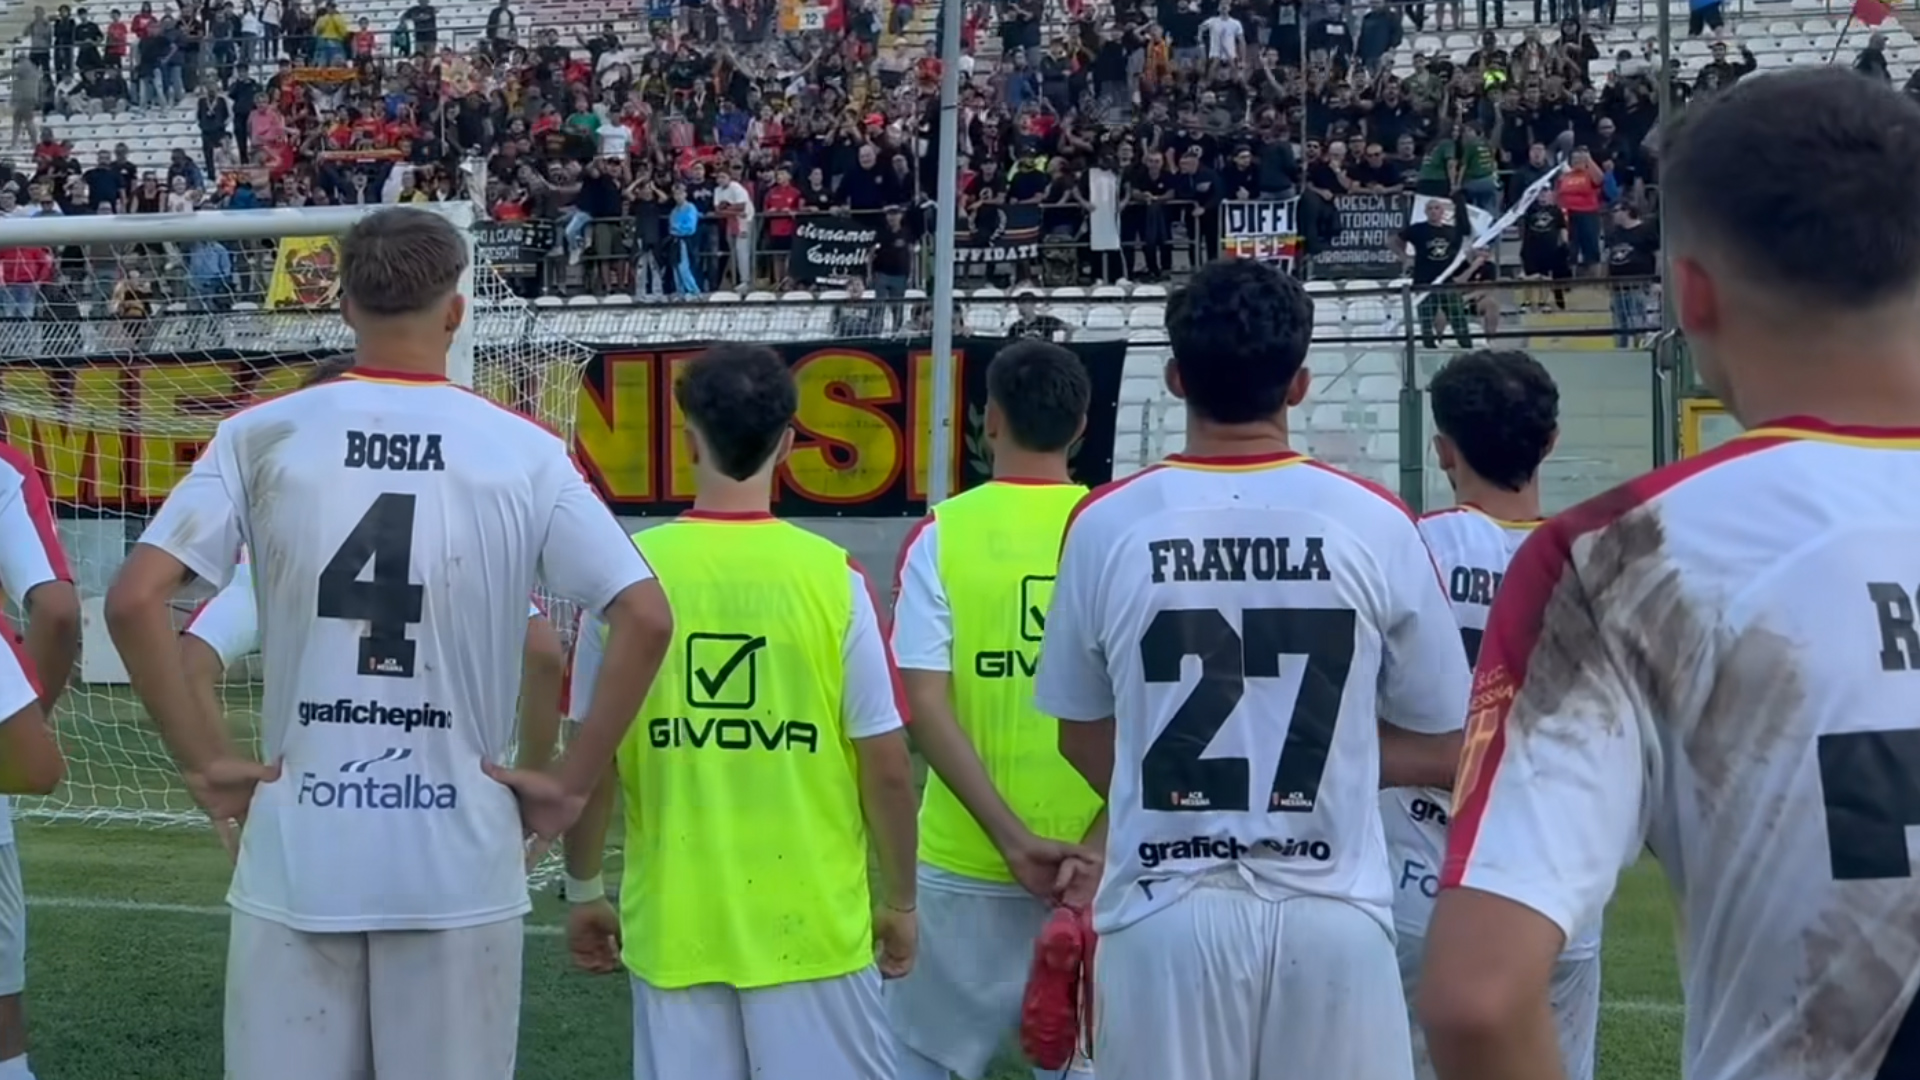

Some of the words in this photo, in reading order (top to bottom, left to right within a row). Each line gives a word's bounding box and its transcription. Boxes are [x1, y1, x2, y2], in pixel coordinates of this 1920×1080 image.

[1228, 203, 1294, 233] DIFFI
[344, 430, 446, 472] BOSIA
[317, 493, 424, 678] 4
[975, 650, 1039, 678] GIV
[1140, 607, 1357, 813] 27
[649, 717, 818, 753] GIVOVA
[298, 772, 457, 810] Fontalba
